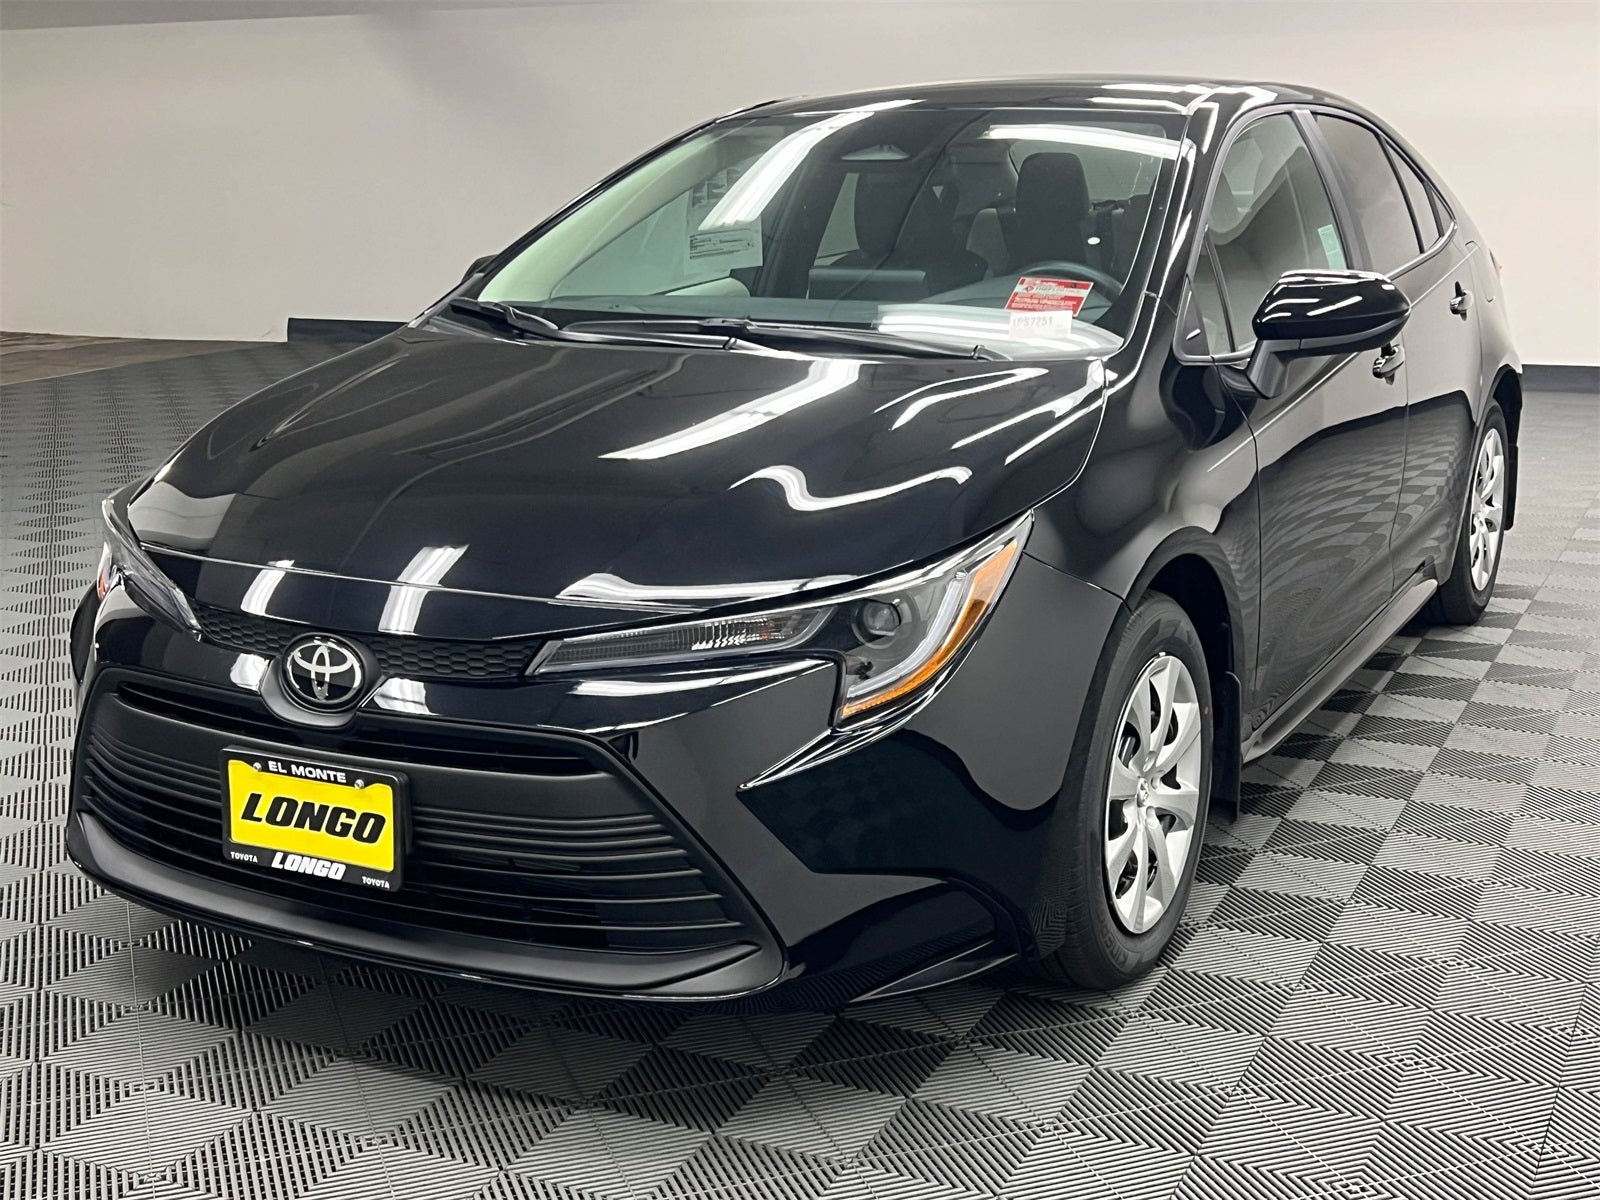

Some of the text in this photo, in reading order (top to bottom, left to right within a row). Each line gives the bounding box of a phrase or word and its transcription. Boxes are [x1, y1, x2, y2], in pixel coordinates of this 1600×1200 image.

[268, 761, 346, 783] EL MONTE
[241, 792, 386, 844] LONGO
[230, 851, 390, 889] TOYOTA LONGO TOYOTA
